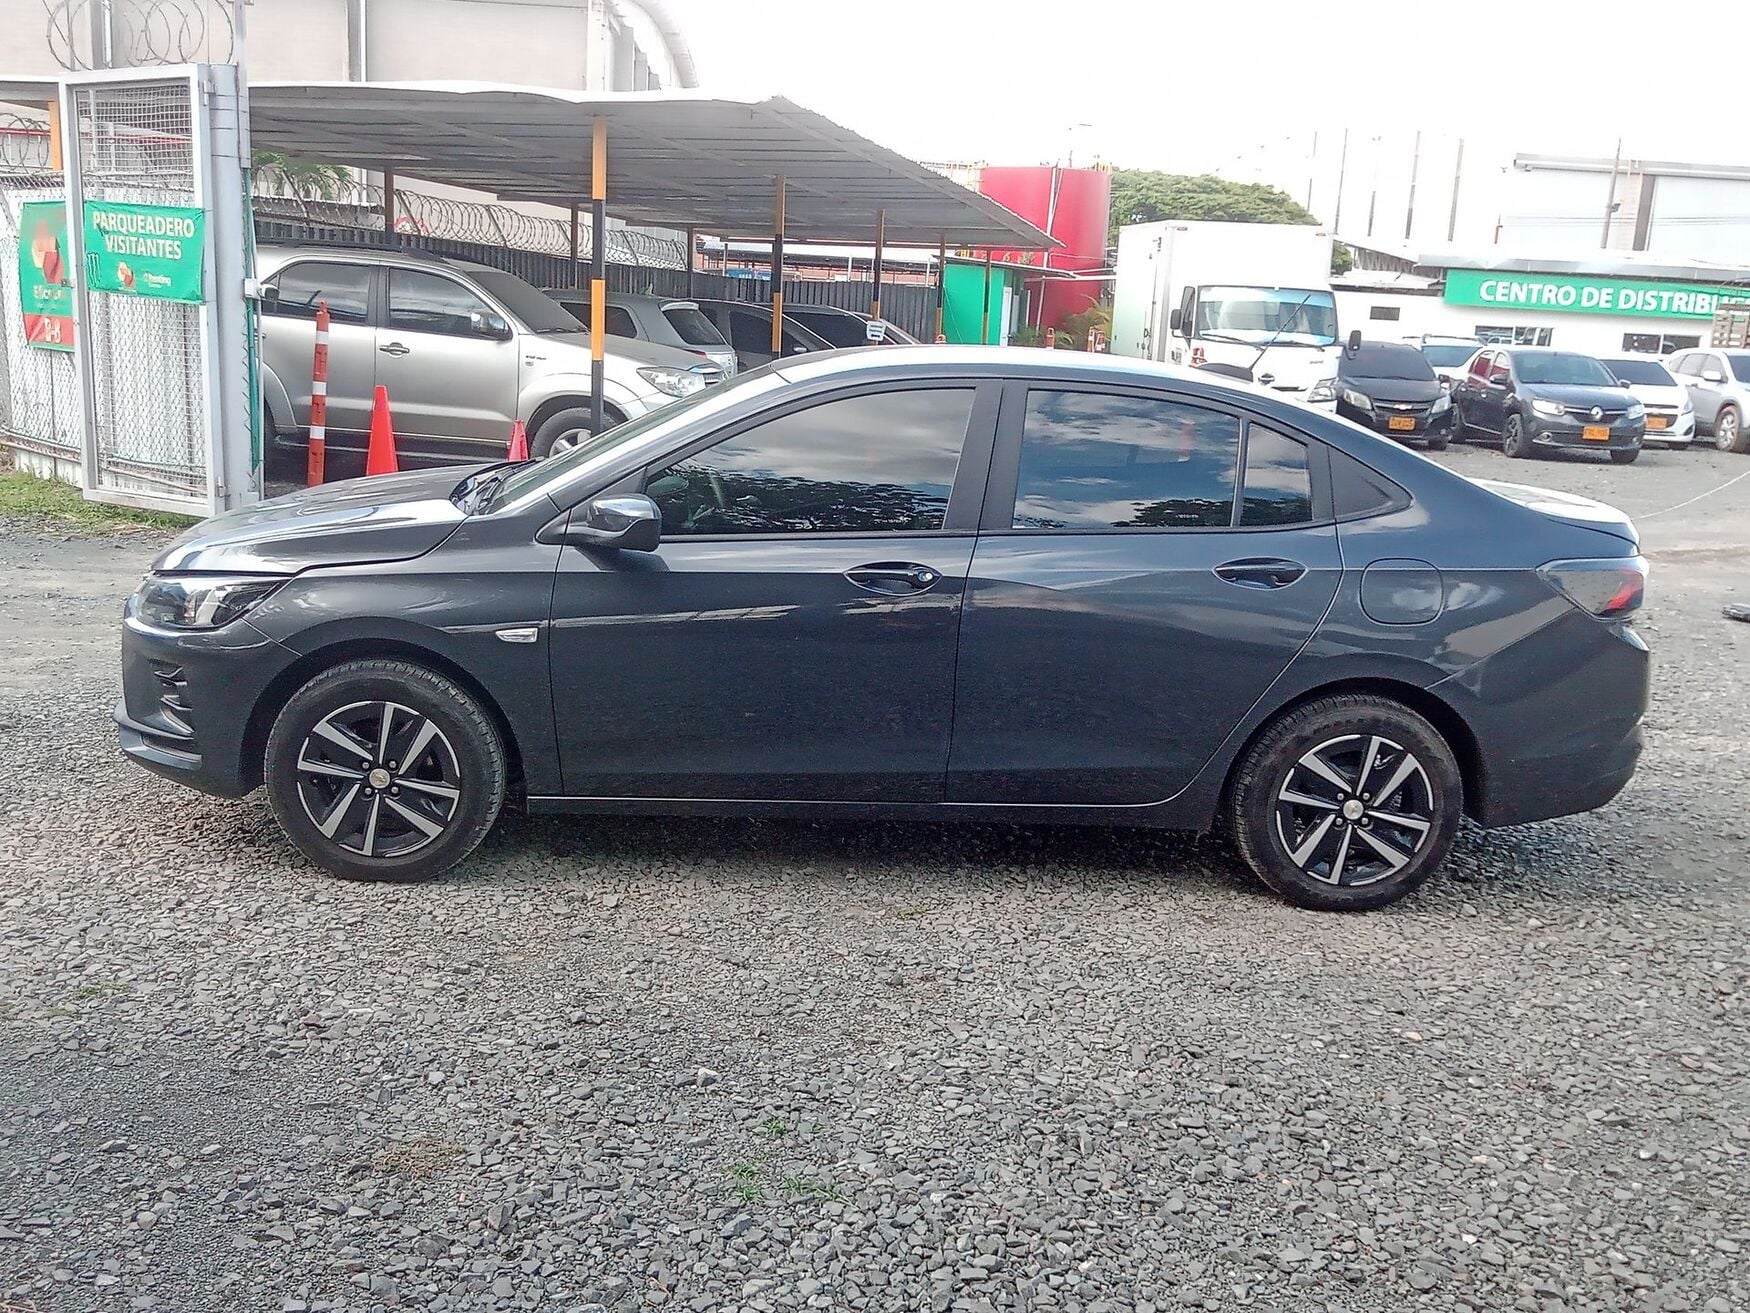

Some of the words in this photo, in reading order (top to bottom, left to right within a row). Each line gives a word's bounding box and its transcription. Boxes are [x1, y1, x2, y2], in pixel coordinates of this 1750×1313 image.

[92, 210, 195, 238] PARQUEADERO
[105, 235, 182, 260] VISITANTES
[1480, 280, 1576, 306] CENTRO
[1580, 286, 1614, 309] DE
